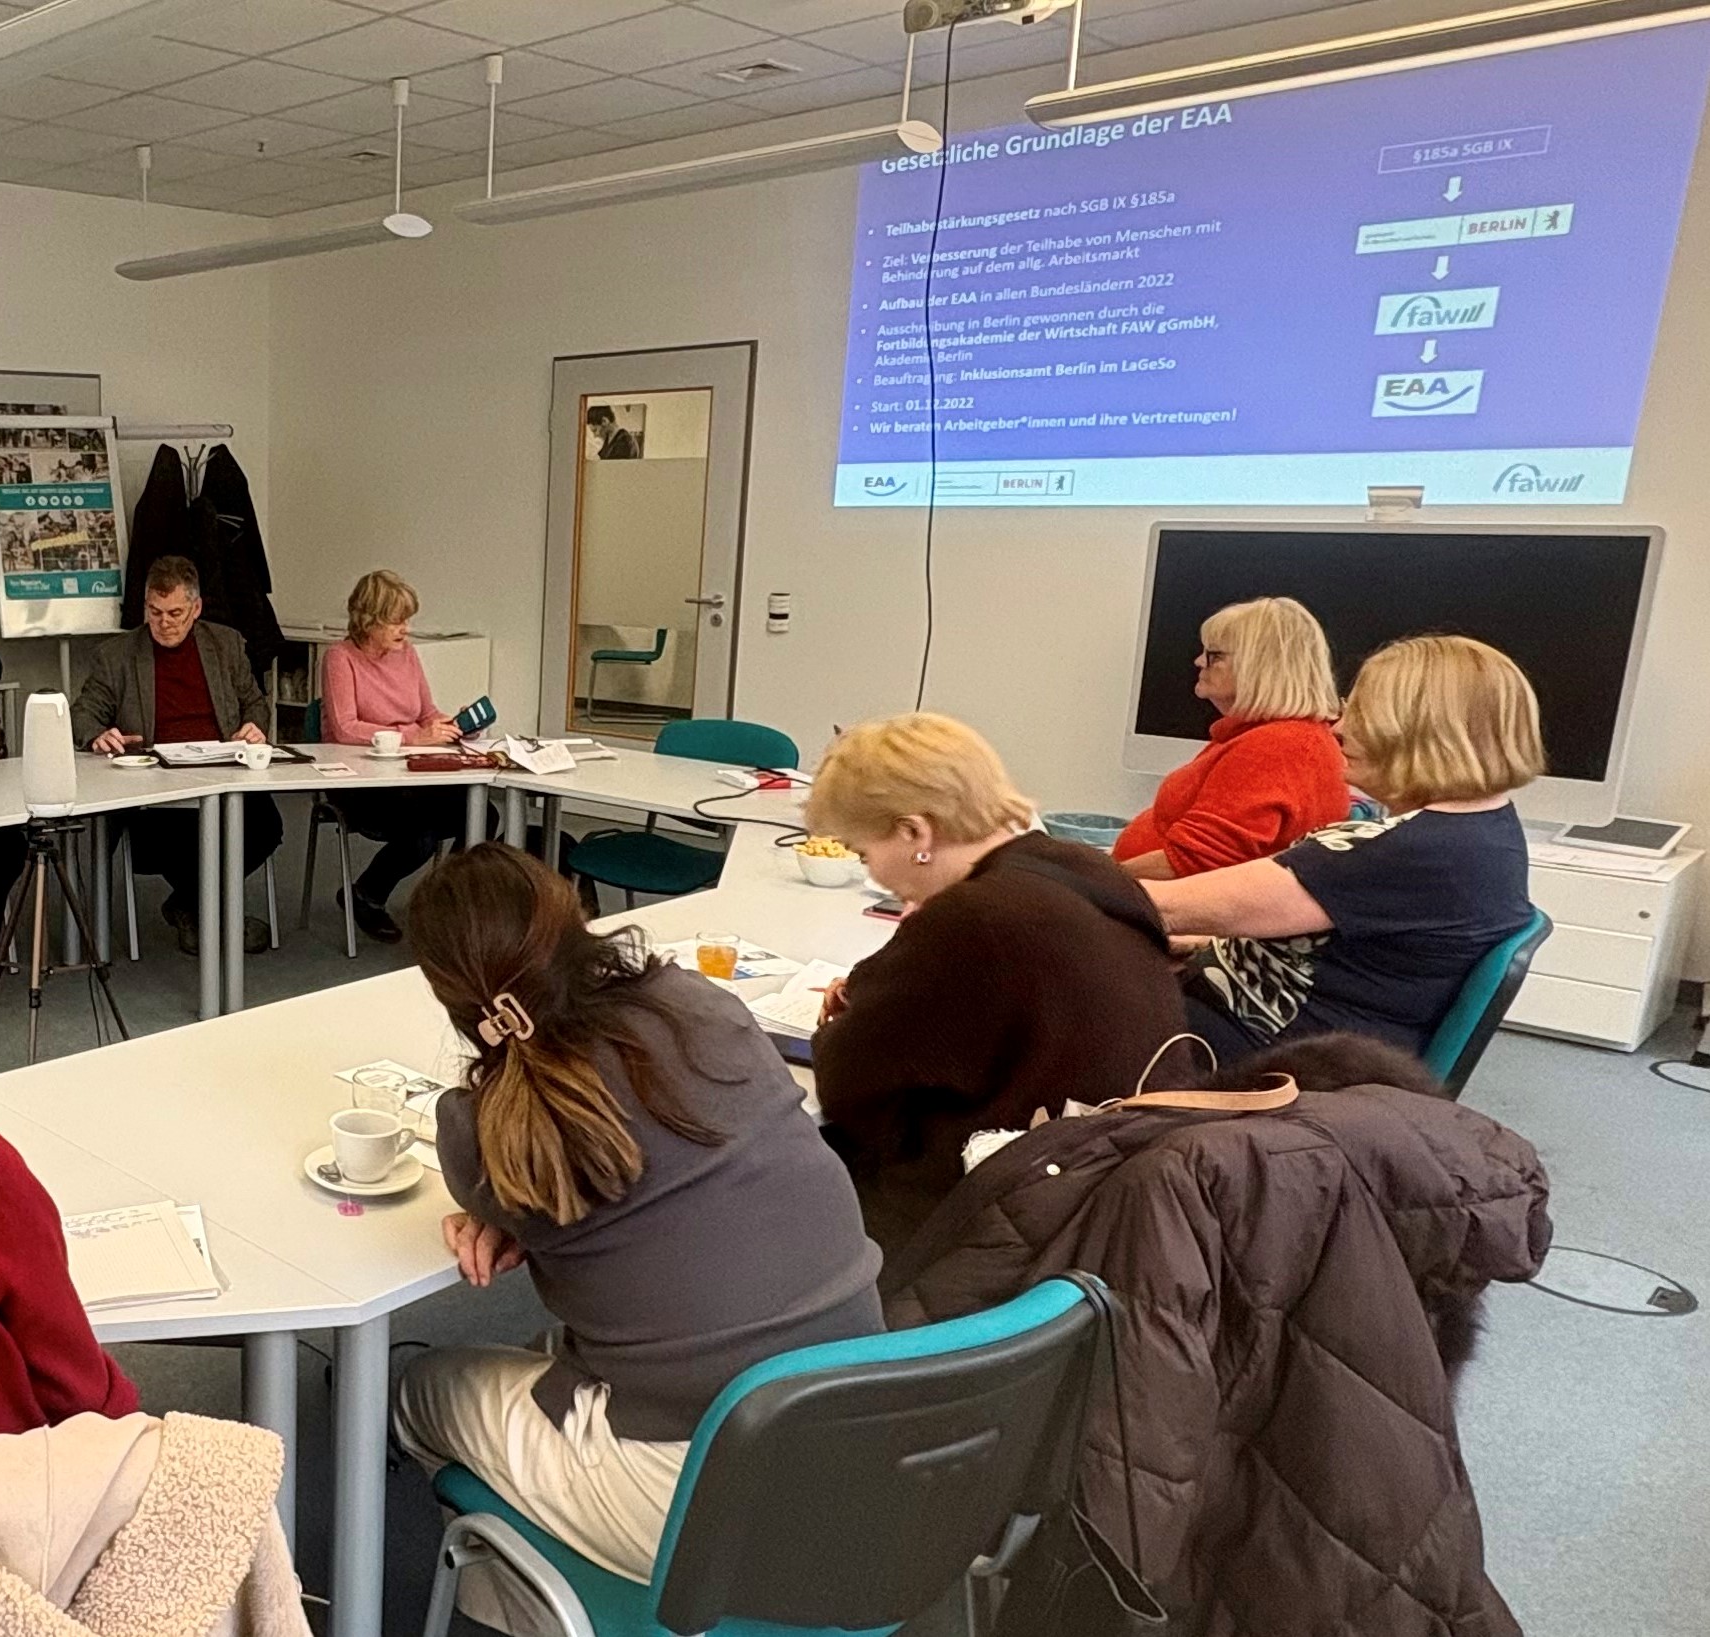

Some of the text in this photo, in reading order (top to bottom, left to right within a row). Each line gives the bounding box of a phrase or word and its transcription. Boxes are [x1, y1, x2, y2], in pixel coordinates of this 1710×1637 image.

[1005, 125, 1124, 156] Grundlage
[1132, 115, 1173, 138] der
[1180, 103, 1232, 129] EAA
[1413, 138, 1514, 164] §185a SGB IX
[1044, 202, 1076, 218] nach
[1080, 198, 1109, 213] SGB
[1113, 196, 1126, 209] IX
[1128, 190, 1176, 208] §185a
[1467, 217, 1527, 235] BERLIN
[882, 254, 908, 268] Ziel:
[1000, 243, 1023, 256] der
[1026, 236, 1082, 254] Teilhabe
[1085, 232, 1111, 246] von
[1115, 223, 1191, 244] Menschen
[1195, 219, 1222, 235] mit
[962, 263, 983, 276] auf
[985, 261, 1015, 274] dem
[1018, 256, 1045, 272] allg.
[1048, 246, 1140, 267] Arbeitsmarkt
[878, 273, 1175, 311] Aufbau der EAA in allen Bundesländern 2022
[968, 317, 981, 330] in
[983, 313, 1021, 329] Berlin
[1023, 309, 1095, 328] gewonnen
[1098, 304, 1138, 320] durch
[1142, 301, 1165, 316] die
[1018, 327, 1042, 342] der
[1044, 321, 1119, 340] Wirtschaft
[1120, 319, 1155, 335] FAW
[1157, 315, 1220, 335] gGmbH,
[936, 350, 973, 363] Berlin
[960, 363, 1052, 381] Inklusionsamt
[1055, 361, 1096, 377] Berlin
[1099, 361, 1118, 374] im
[1121, 357, 1177, 373] LaGeSo
[1384, 377, 1450, 397] EAA
[871, 401, 903, 413] Start:
[869, 421, 891, 434] Wir
[1069, 412, 1096, 428] und
[1099, 411, 1128, 426] ihre
[1132, 407, 1238, 426] Vertretungen!
[864, 477, 896, 488] EAA
[1002, 478, 1043, 489] BERLIN
